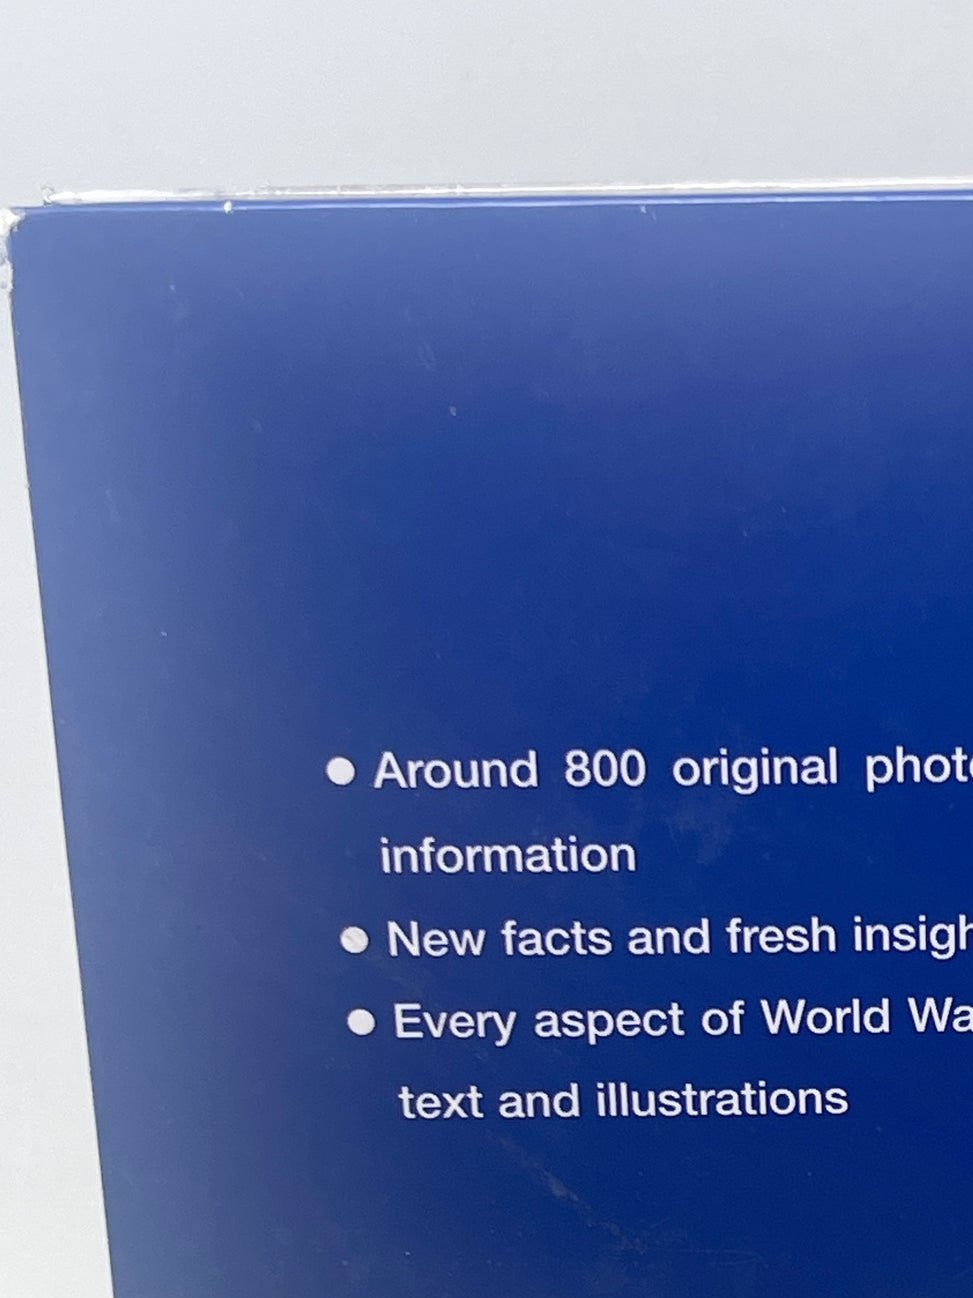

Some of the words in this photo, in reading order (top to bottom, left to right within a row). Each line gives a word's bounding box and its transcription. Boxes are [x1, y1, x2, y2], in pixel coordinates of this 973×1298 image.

[374, 749, 538, 789] Around
[565, 749, 646, 787] 800
[672, 746, 837, 795] original
[380, 835, 636, 874] information
[387, 920, 486, 957] New
[500, 919, 612, 956] facts
[628, 917, 710, 955] and
[725, 916, 836, 953] fresh
[394, 1003, 517, 1047] Every
[535, 1002, 685, 1045] aspect
[701, 1000, 745, 1036] of
[760, 997, 890, 1034] World
[397, 1085, 484, 1119] text
[499, 1082, 580, 1118] and
[597, 1080, 848, 1117] illustrations
